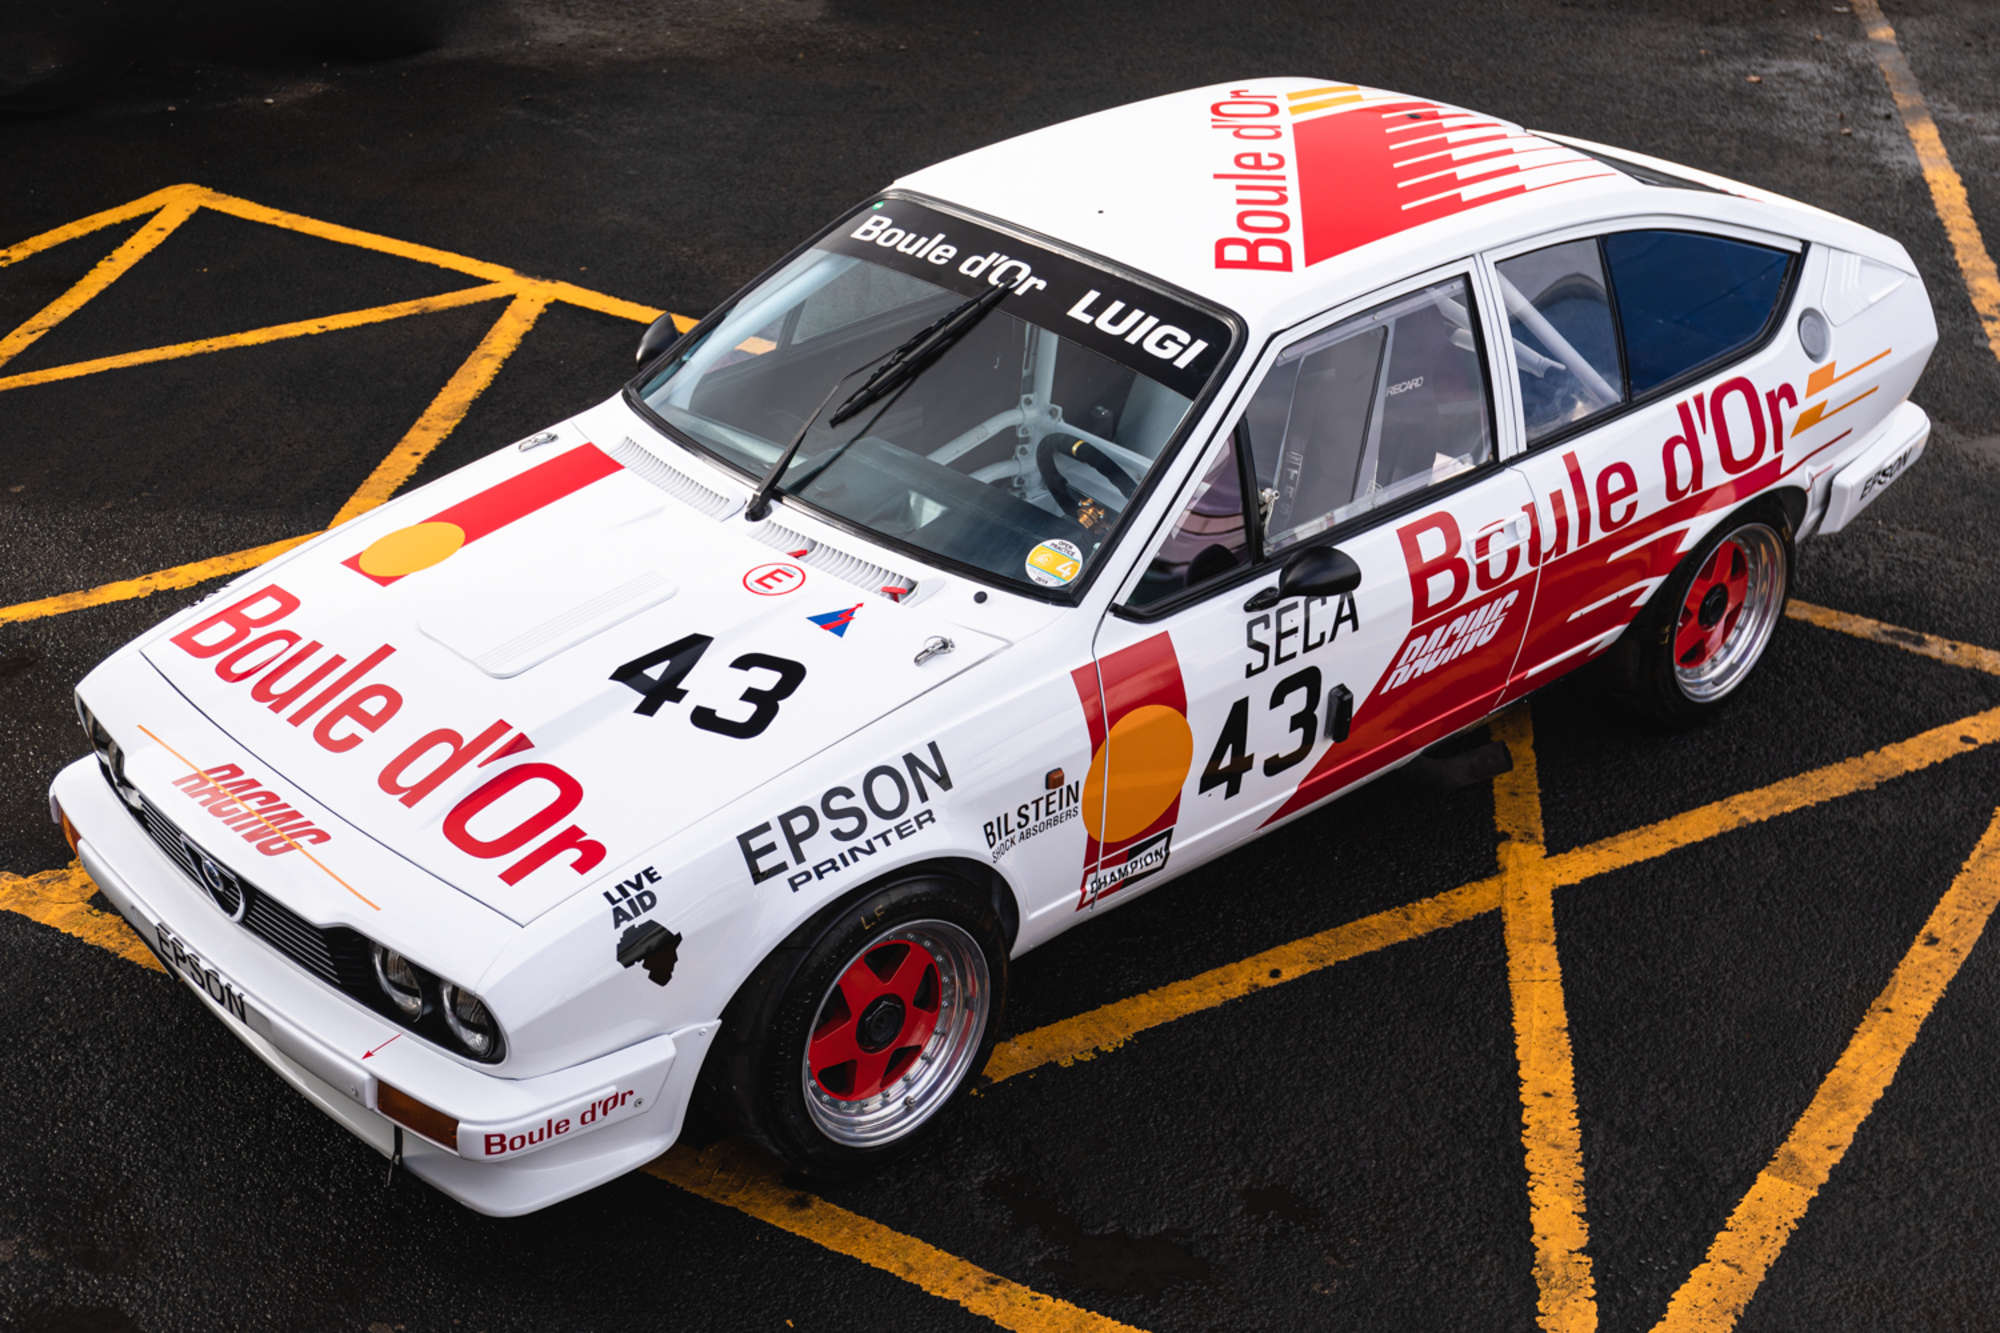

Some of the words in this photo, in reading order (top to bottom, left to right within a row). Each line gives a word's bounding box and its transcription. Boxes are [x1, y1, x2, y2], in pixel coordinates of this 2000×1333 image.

[1210, 89, 1283, 140] d'Or
[1213, 151, 1293, 273] Boule
[850, 214, 958, 265] Boule
[958, 251, 1047, 296] d'Or
[1067, 290, 1208, 369] LUIGI
[1396, 450, 1638, 626] Boule
[1662, 375, 1799, 502] d'Or
[754, 568, 795, 590] E
[1056, 560, 1074, 578] 4
[1246, 590, 1359, 679] SECA
[1379, 589, 1519, 696] RACING
[609, 632, 807, 740] 43
[169, 583, 404, 753] Boule
[377, 718, 608, 887] d'Or
[1199, 665, 1322, 801] 43
[171, 763, 332, 857] RACING
[736, 740, 953, 886] EPSON
[788, 809, 936, 893] PRINTER
[984, 780, 1080, 849] BILSTEIN
[991, 834, 1017, 864] SHOCK
[1018, 805, 1080, 842] ABSORBERS
[603, 866, 662, 906] LIVE
[612, 890, 657, 930] AID
[1089, 846, 1165, 895] CHAMPION
[155, 922, 248, 1025] EPSON
[484, 1118, 571, 1156] Boule
[580, 1090, 634, 1126] d'Or
